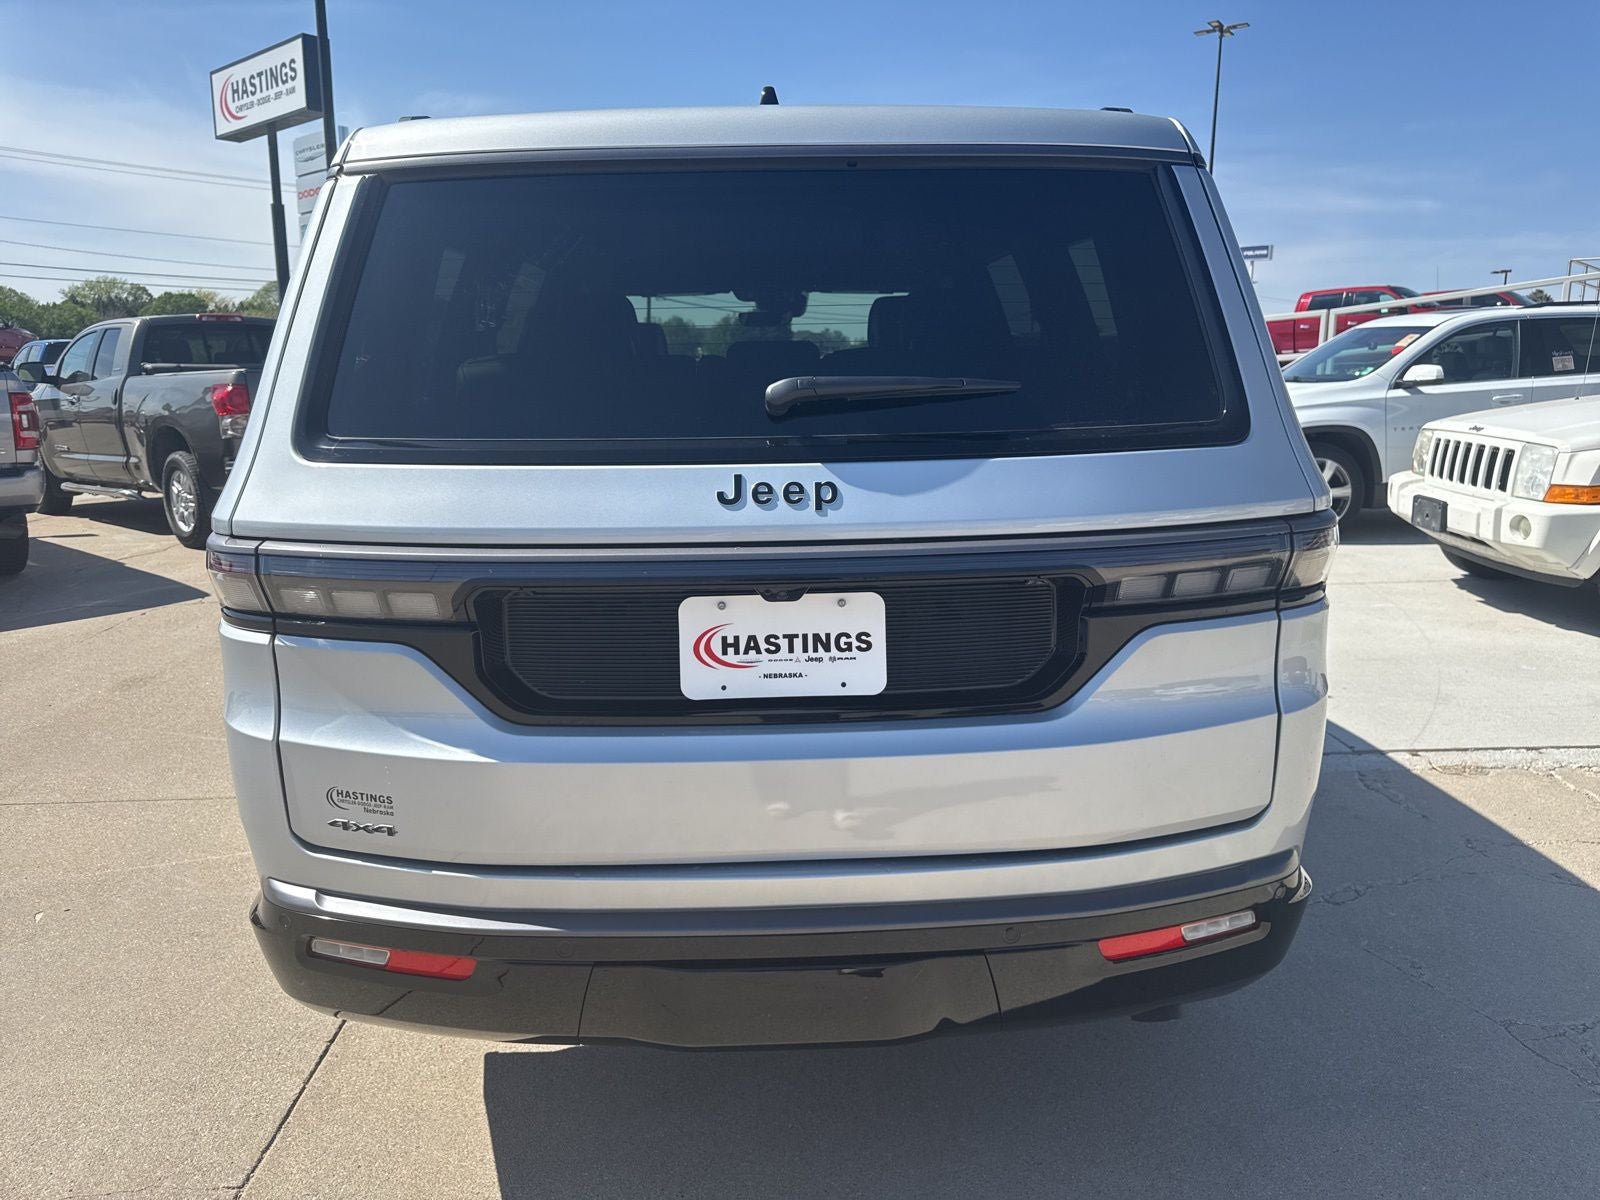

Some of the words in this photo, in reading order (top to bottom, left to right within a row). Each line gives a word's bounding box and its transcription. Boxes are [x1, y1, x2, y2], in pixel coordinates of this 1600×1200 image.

[231, 58, 297, 103] HASTINGS
[716, 473, 839, 512] Jeep
[721, 631, 873, 656] HASTINGS
[804, 655, 824, 663] Jeep
[336, 789, 393, 804] HASTINGS
[363, 807, 394, 816] Nebraska
